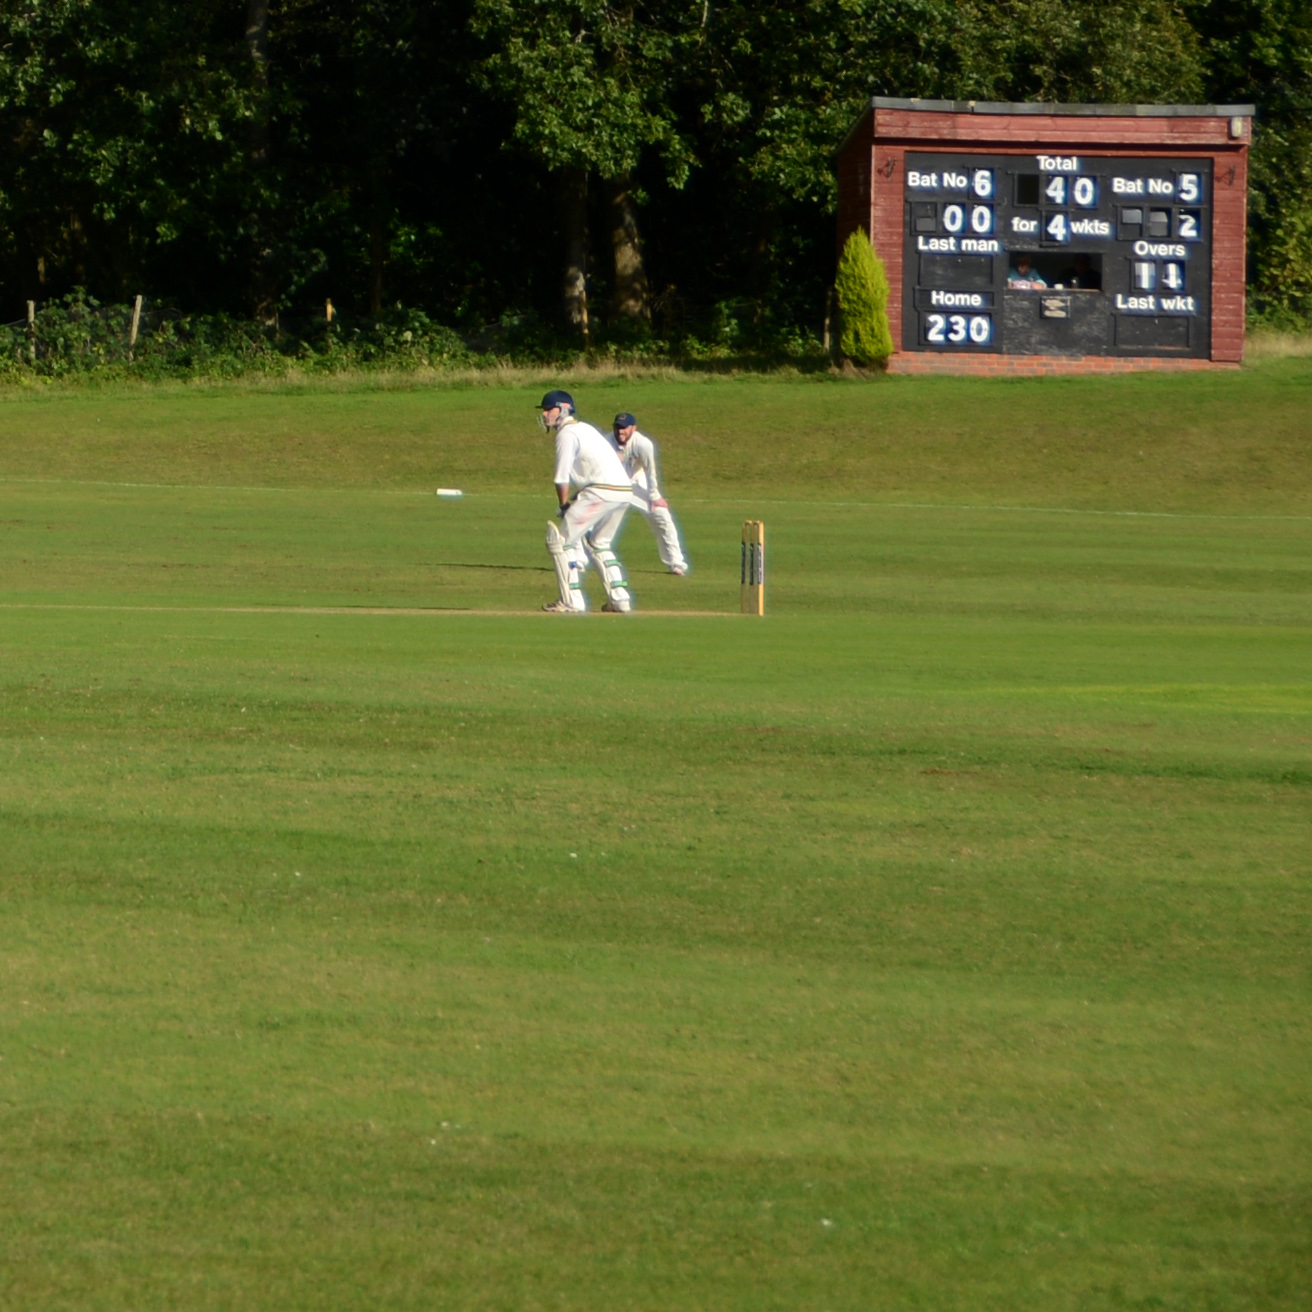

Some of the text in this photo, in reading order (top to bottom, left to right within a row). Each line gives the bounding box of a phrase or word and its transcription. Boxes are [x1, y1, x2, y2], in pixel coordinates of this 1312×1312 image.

[1036, 155, 1078, 171] Total
[908, 171, 992, 196] Bat No 6
[1112, 174, 1197, 201] Bat No 5
[1012, 214, 1109, 241] for 4 wkts
[1178, 214, 1196, 237] 2
[918, 236, 998, 252] Last man
[1135, 241, 1185, 256] Overs
[931, 290, 982, 307] Home
[1116, 294, 1194, 311] Last wkt
[927, 315, 989, 342] 230
